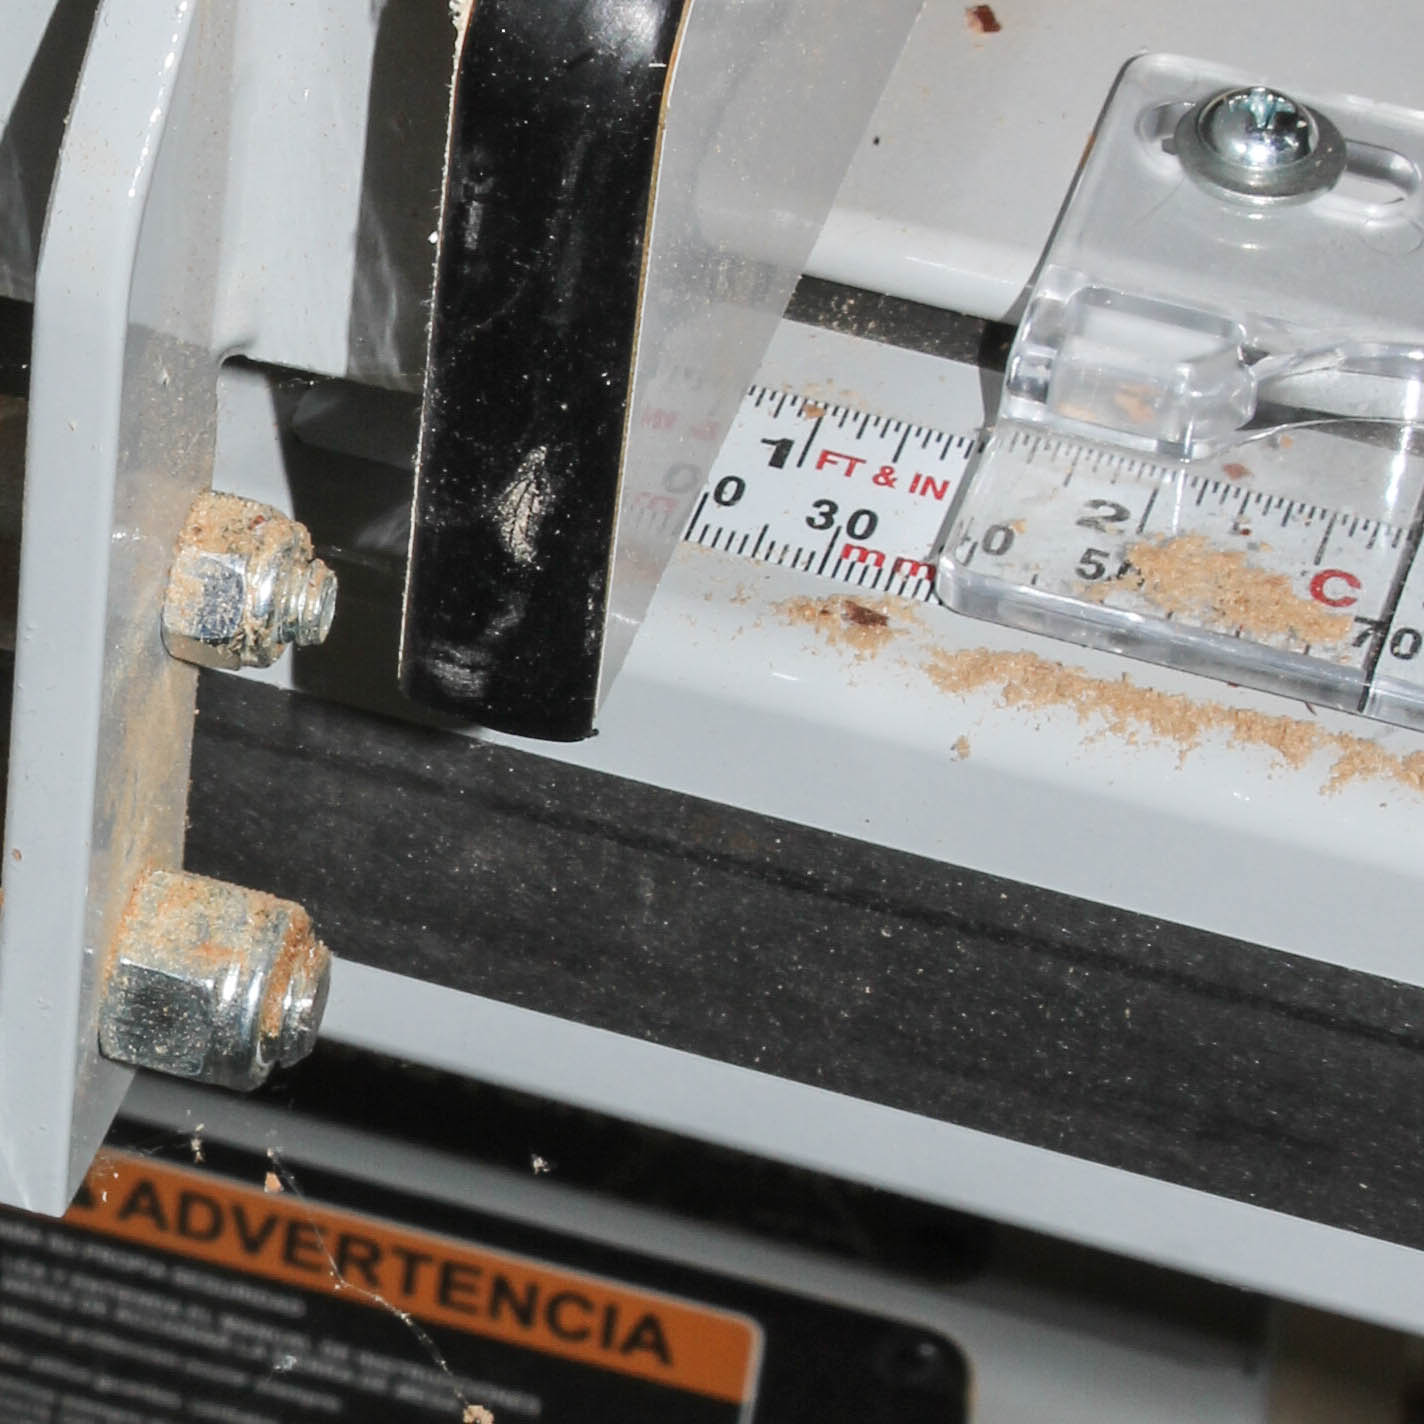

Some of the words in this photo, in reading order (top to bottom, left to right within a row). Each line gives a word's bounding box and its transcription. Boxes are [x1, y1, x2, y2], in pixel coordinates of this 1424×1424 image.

[814, 449, 867, 479] FT
[872, 465, 898, 488] &
[910, 472, 951, 502] IN
[805, 498, 880, 541] 30
[1075, 498, 1132, 534] 2
[115, 1179, 676, 1369] ADVERTENCIA
